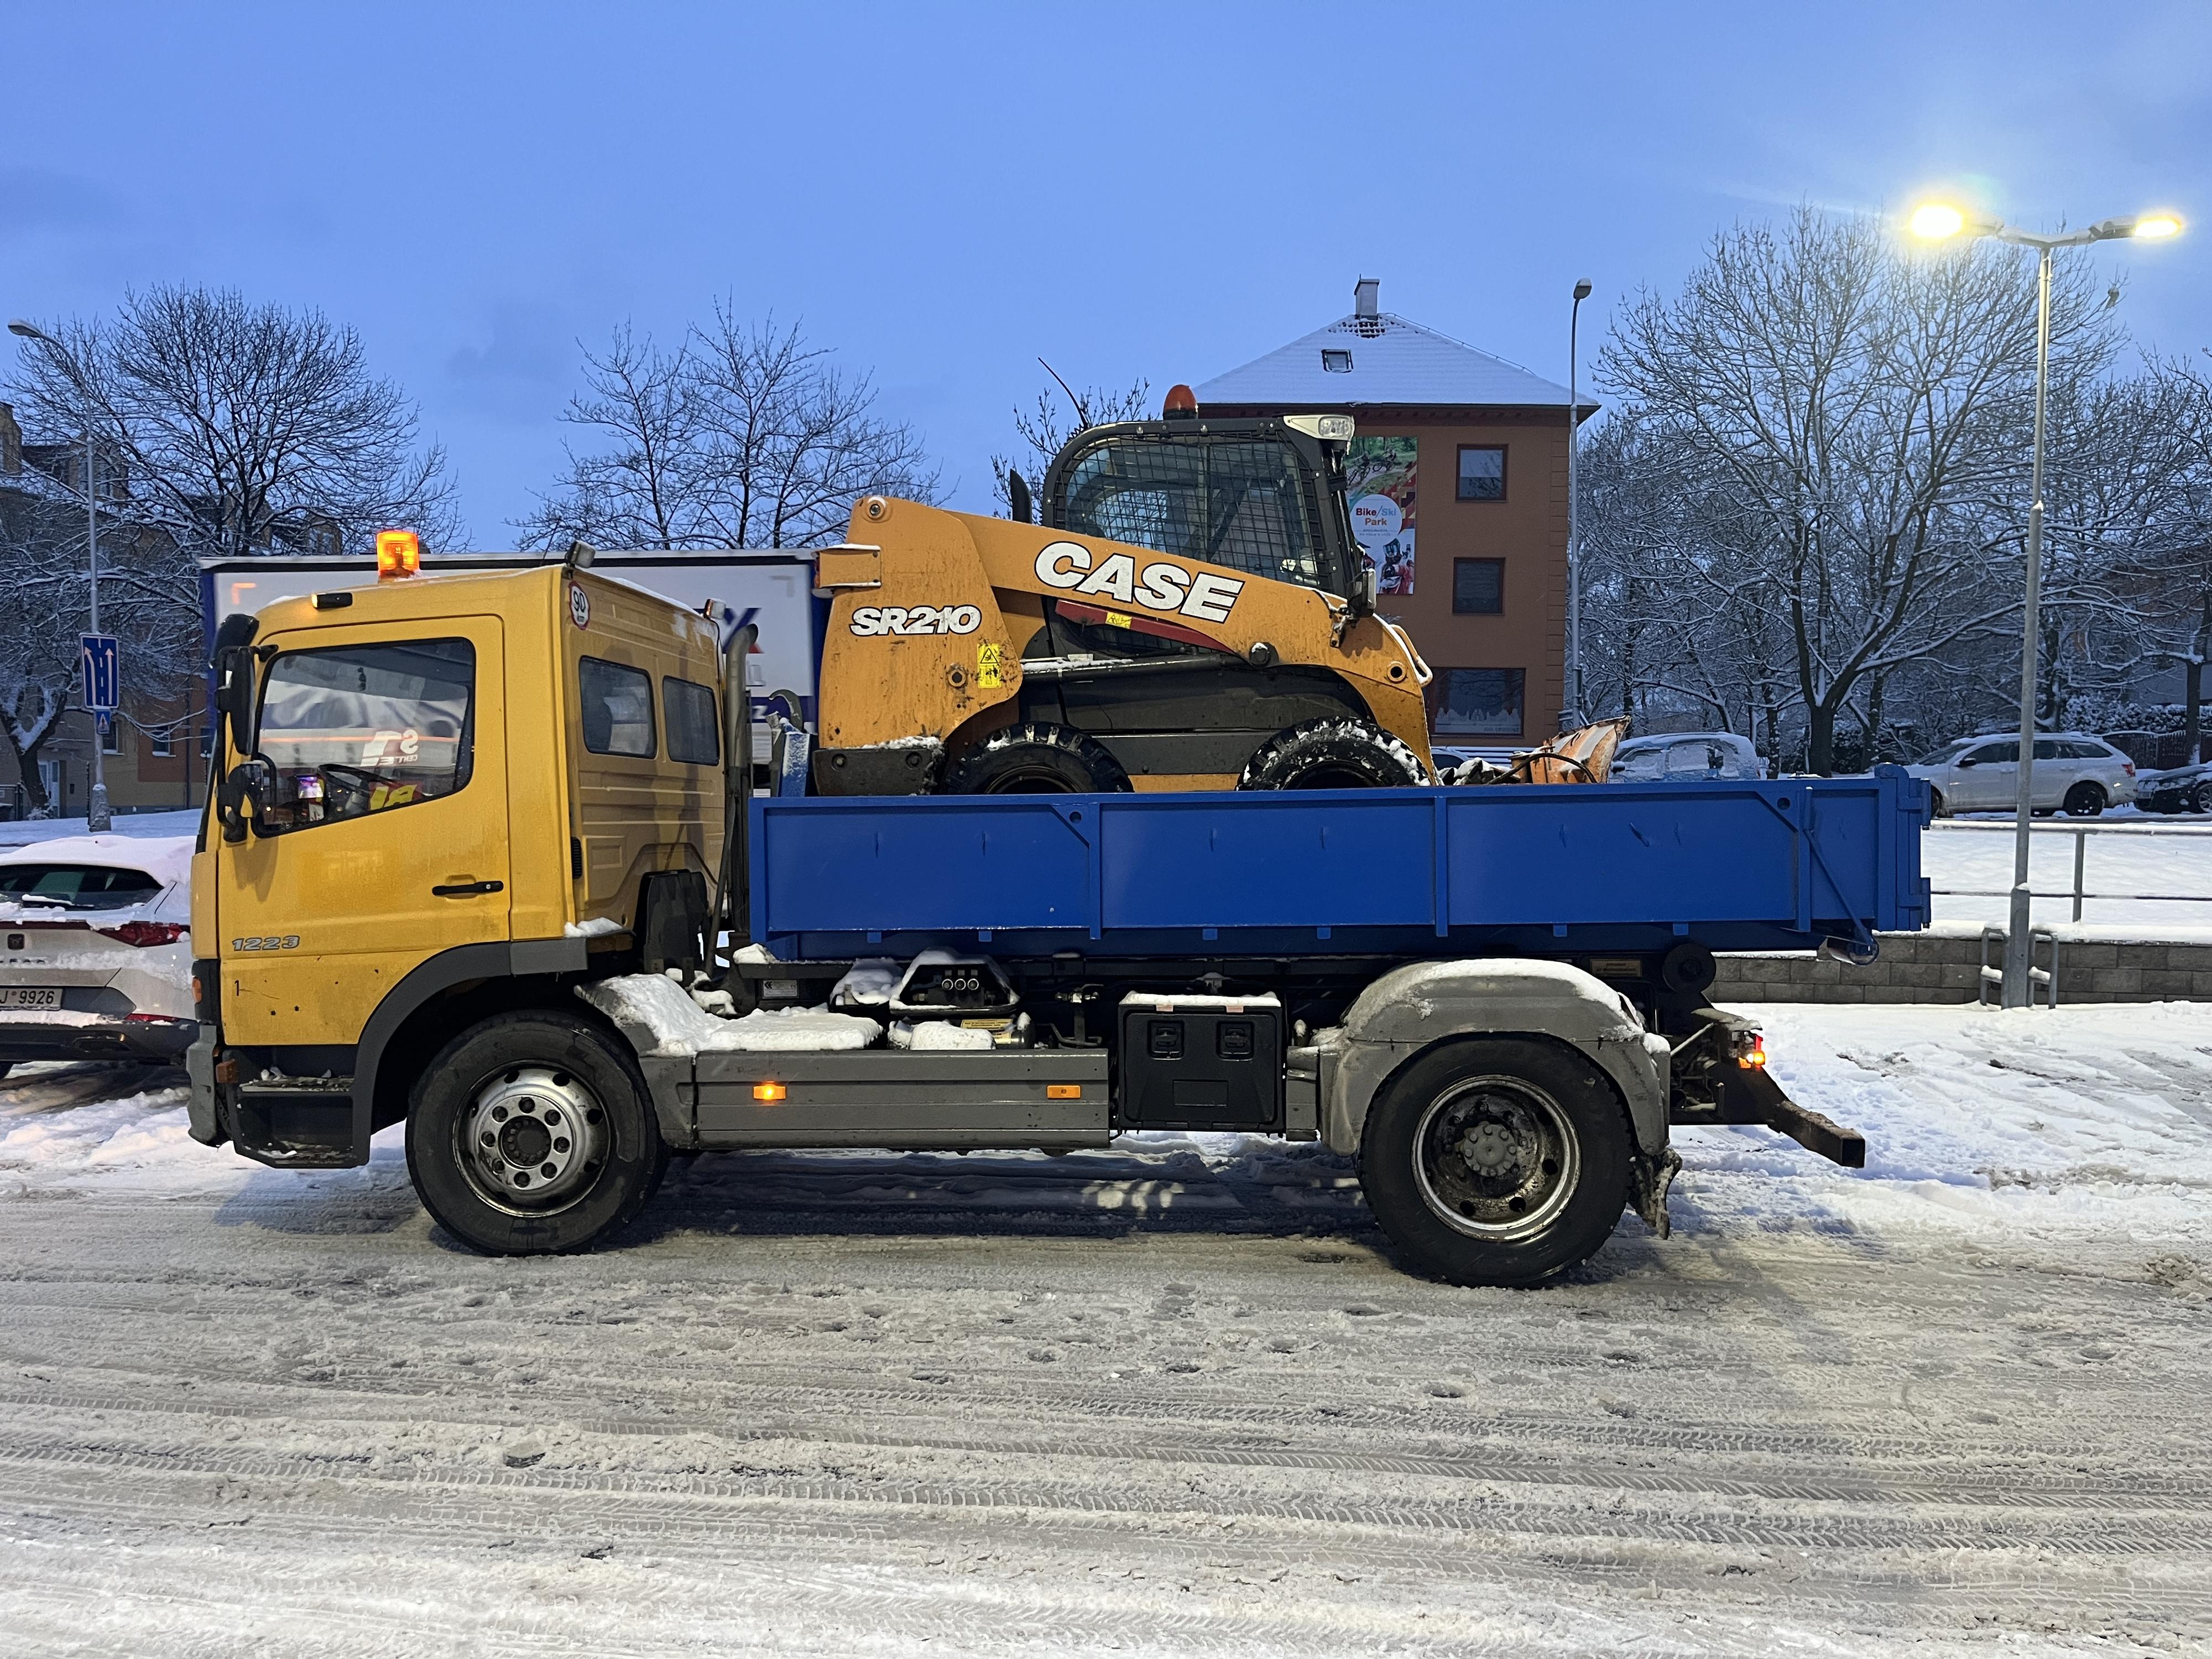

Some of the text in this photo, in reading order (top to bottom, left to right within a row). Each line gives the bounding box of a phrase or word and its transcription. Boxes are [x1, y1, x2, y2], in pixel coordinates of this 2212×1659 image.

[1356, 505, 1396, 518] Bike/Ski
[1034, 541, 1245, 624] CASE
[573, 591, 586, 613] 90
[849, 605, 982, 636] SR210
[231, 935, 300, 951] 1223
[18, 990, 55, 1004] 9926
